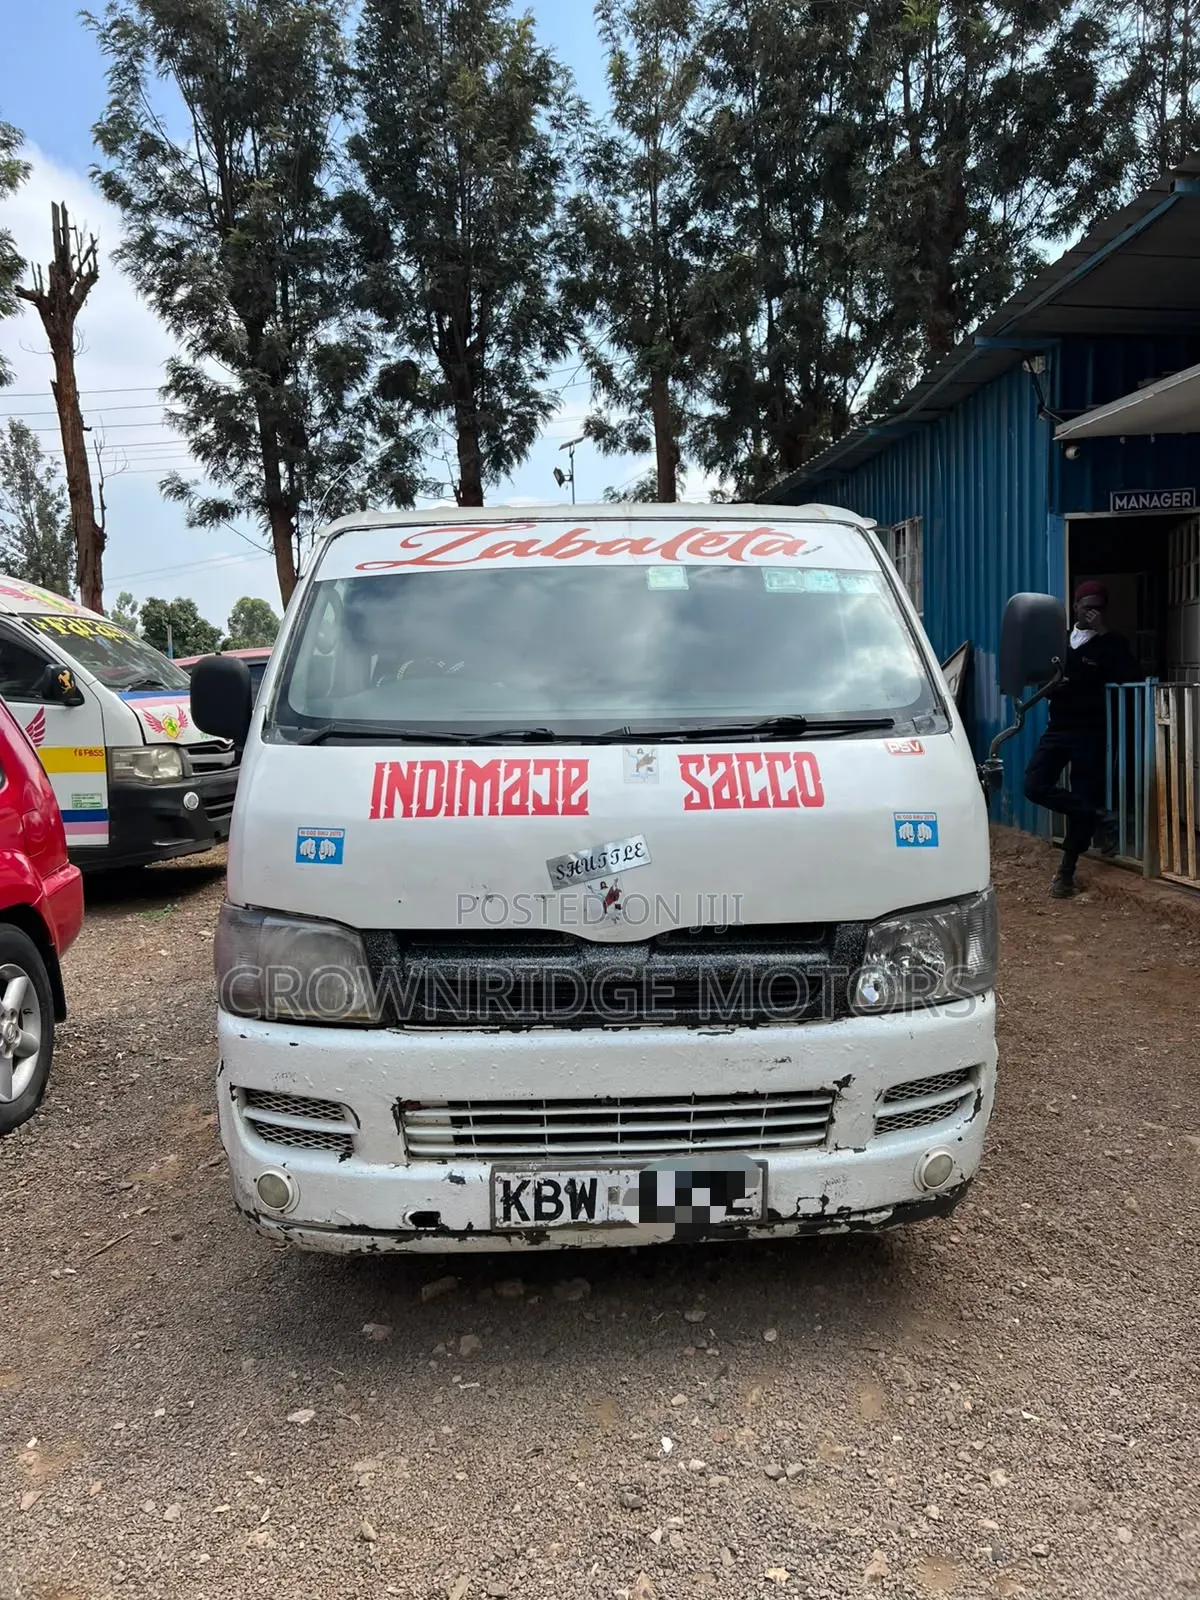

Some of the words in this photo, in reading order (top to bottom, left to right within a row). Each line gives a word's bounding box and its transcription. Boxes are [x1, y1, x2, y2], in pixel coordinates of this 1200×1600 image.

[1114, 491, 1193, 510] MANAGER
[887, 740, 922, 753] PSV
[555, 841, 646, 881] SHUTTLE
[501, 1176, 598, 1222] KBW
